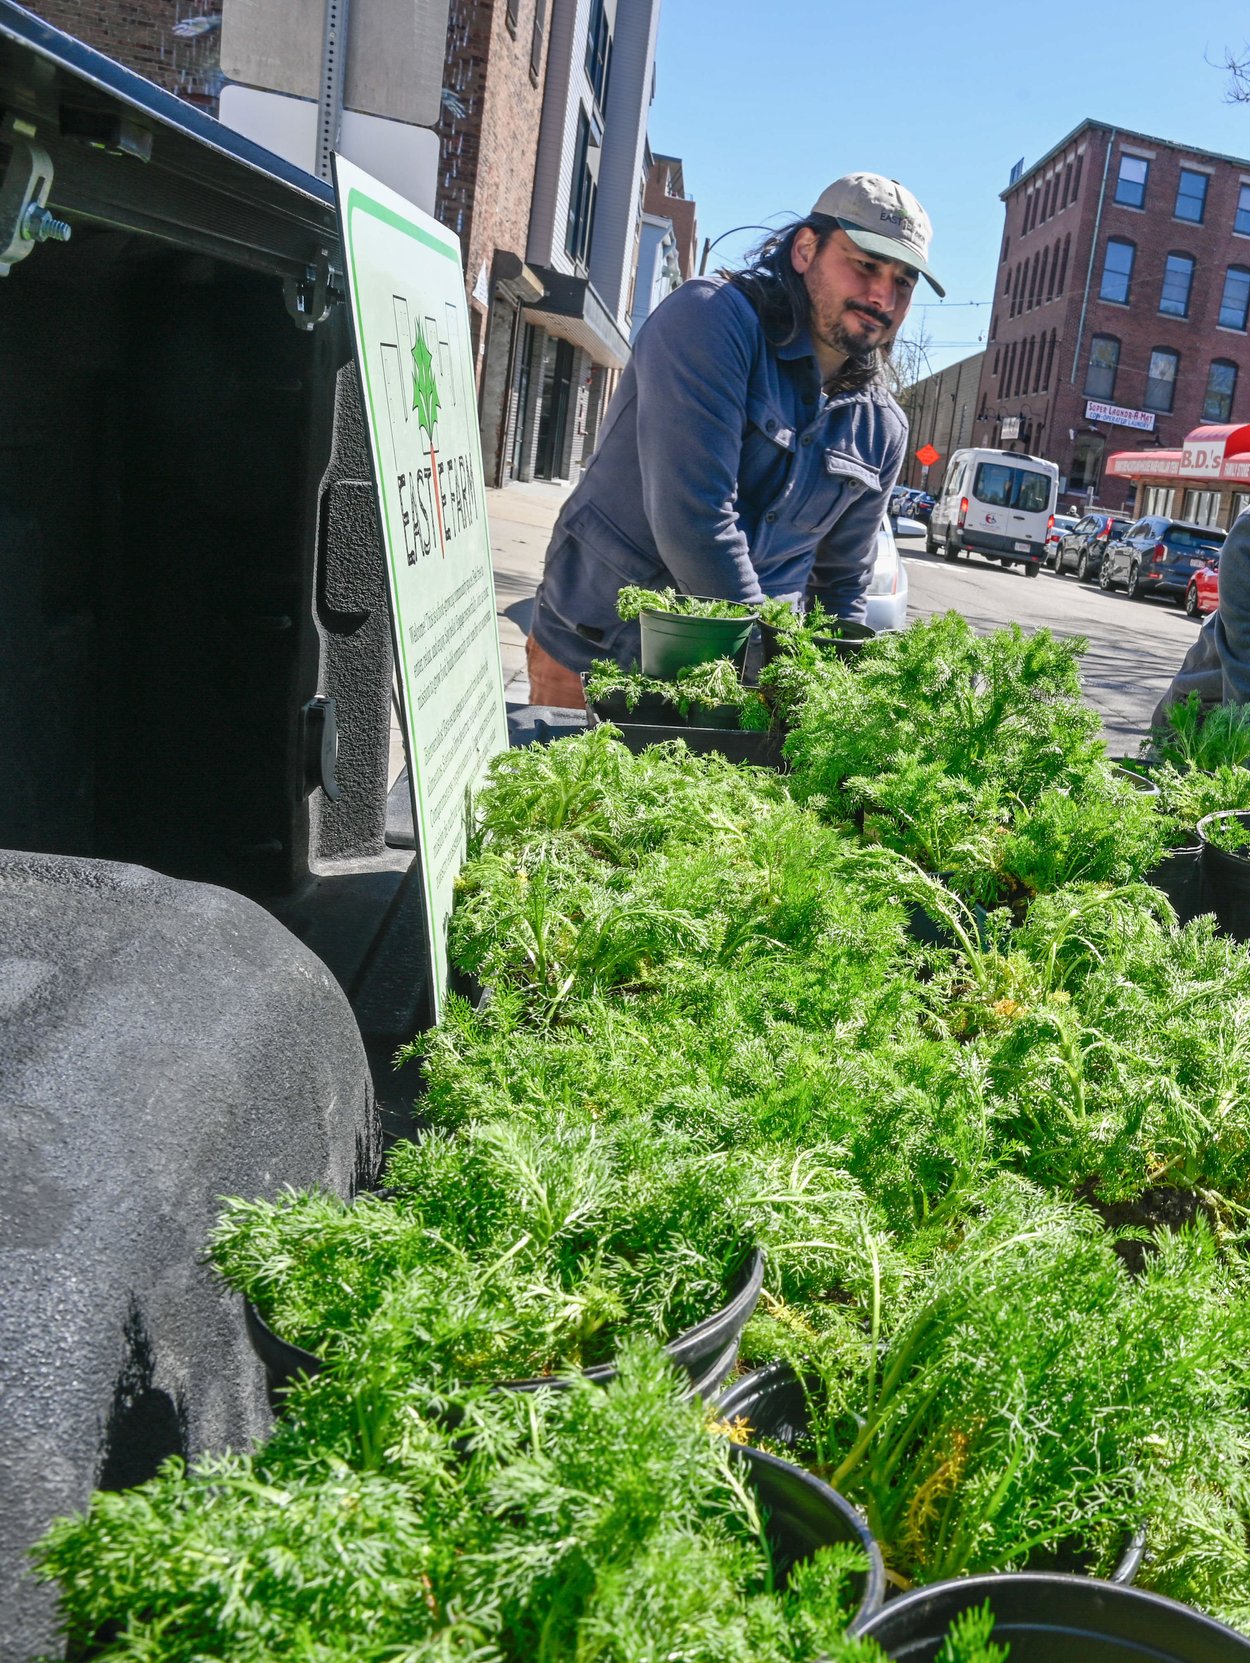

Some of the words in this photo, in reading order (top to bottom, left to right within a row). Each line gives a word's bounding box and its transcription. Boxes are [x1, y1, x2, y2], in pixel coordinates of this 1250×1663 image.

[1088, 402, 1108, 413] SUPER
[1180, 449, 1221, 469] B.D.'s
[447, 452, 479, 538] FARM
